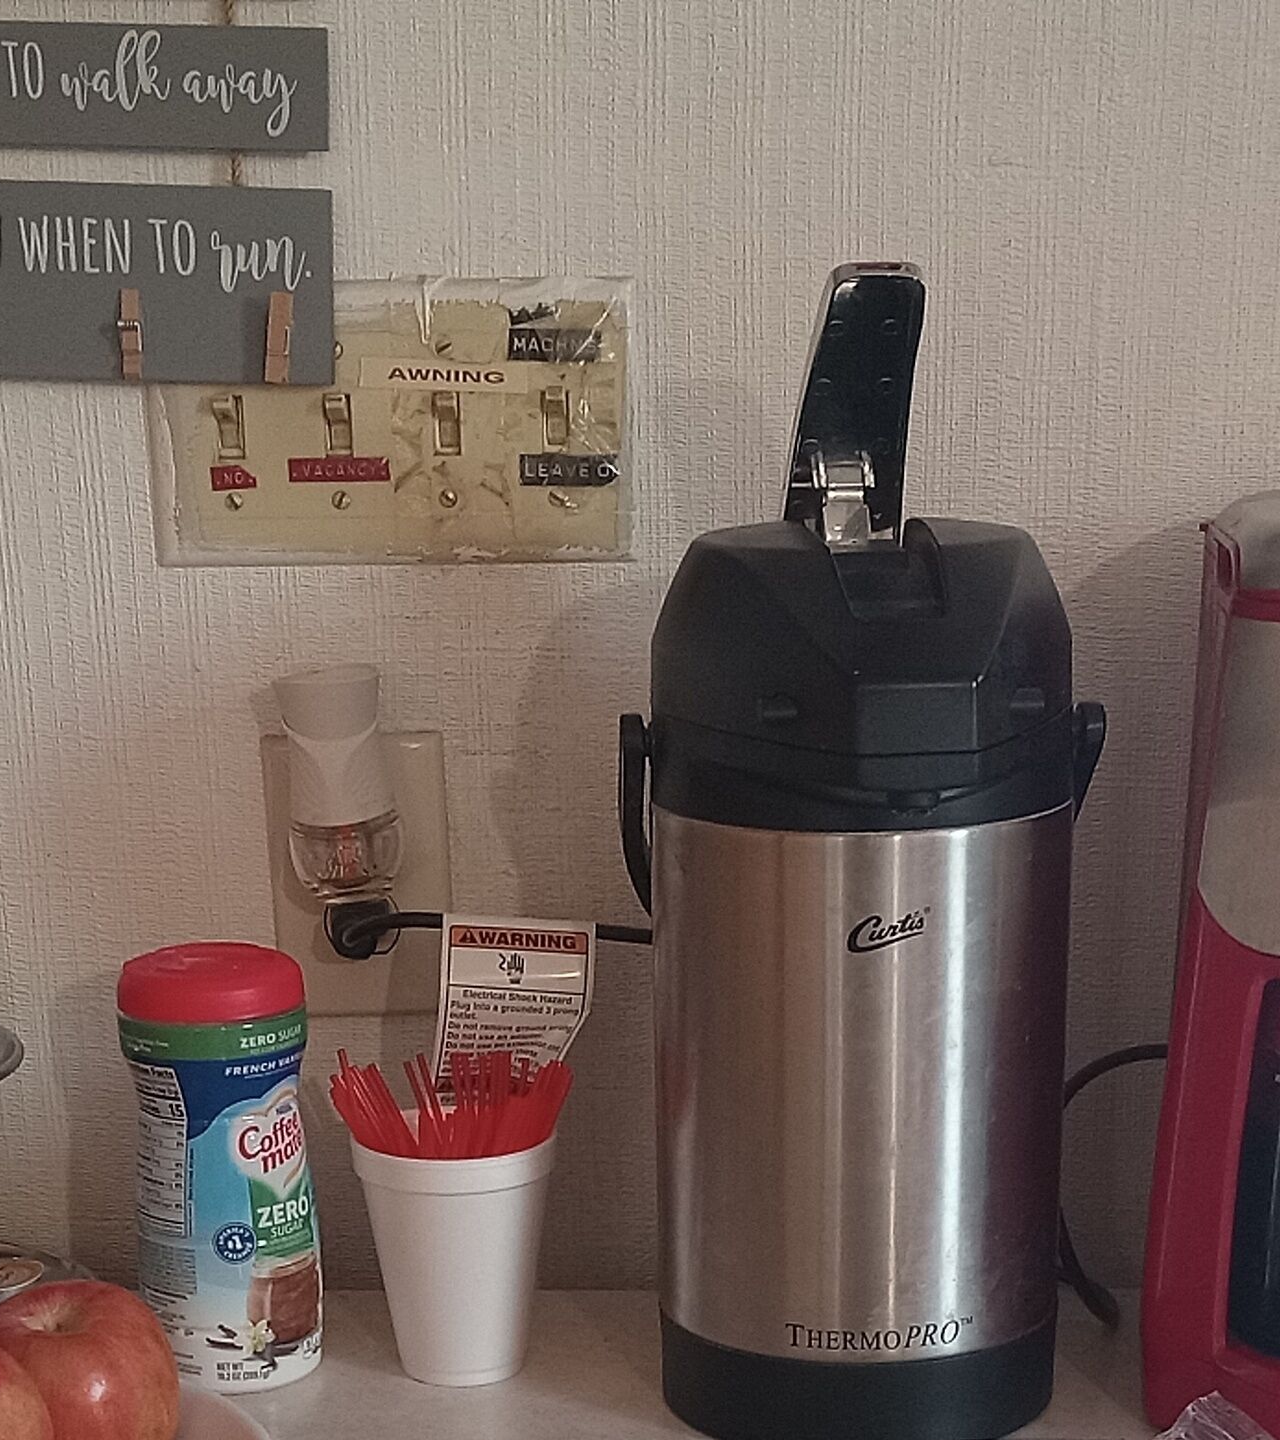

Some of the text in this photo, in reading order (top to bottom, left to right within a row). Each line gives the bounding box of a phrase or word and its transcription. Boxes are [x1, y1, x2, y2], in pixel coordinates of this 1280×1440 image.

[1, 41, 46, 100] TO
[60, 28, 171, 112] walk
[181, 67, 298, 137] away
[18, 215, 132, 276] WHEN
[148, 218, 196, 276] TO
[209, 227, 314, 294] run.
[388, 366, 507, 385] AWNING
[303, 463, 379, 477] VACANCY
[524, 457, 590, 478] LEAVE
[477, 930, 577, 950] WARNING
[847, 910, 924, 953] Curtis
[462, 989, 573, 1006] Electrical Shock Hazard
[450, 1001, 471, 1013] Plug
[501, 1003, 543, 1016] grounded
[448, 1021, 461, 1031] Do
[463, 1021, 478, 1031] not
[480, 1023, 513, 1032] remove
[240, 1034, 276, 1050] ZERO
[447, 1031, 460, 1040] Do
[461, 1031, 477, 1041] not
[479, 1033, 495, 1041] use
[446, 1040, 458, 1050] Do
[459, 1040, 474, 1050] not
[477, 1042, 492, 1050] use
[225, 1060, 276, 1076] FRENCH
[169, 1103, 185, 1119] 15
[238, 1111, 300, 1161] Coffee
[257, 1194, 310, 1230] ZERO
